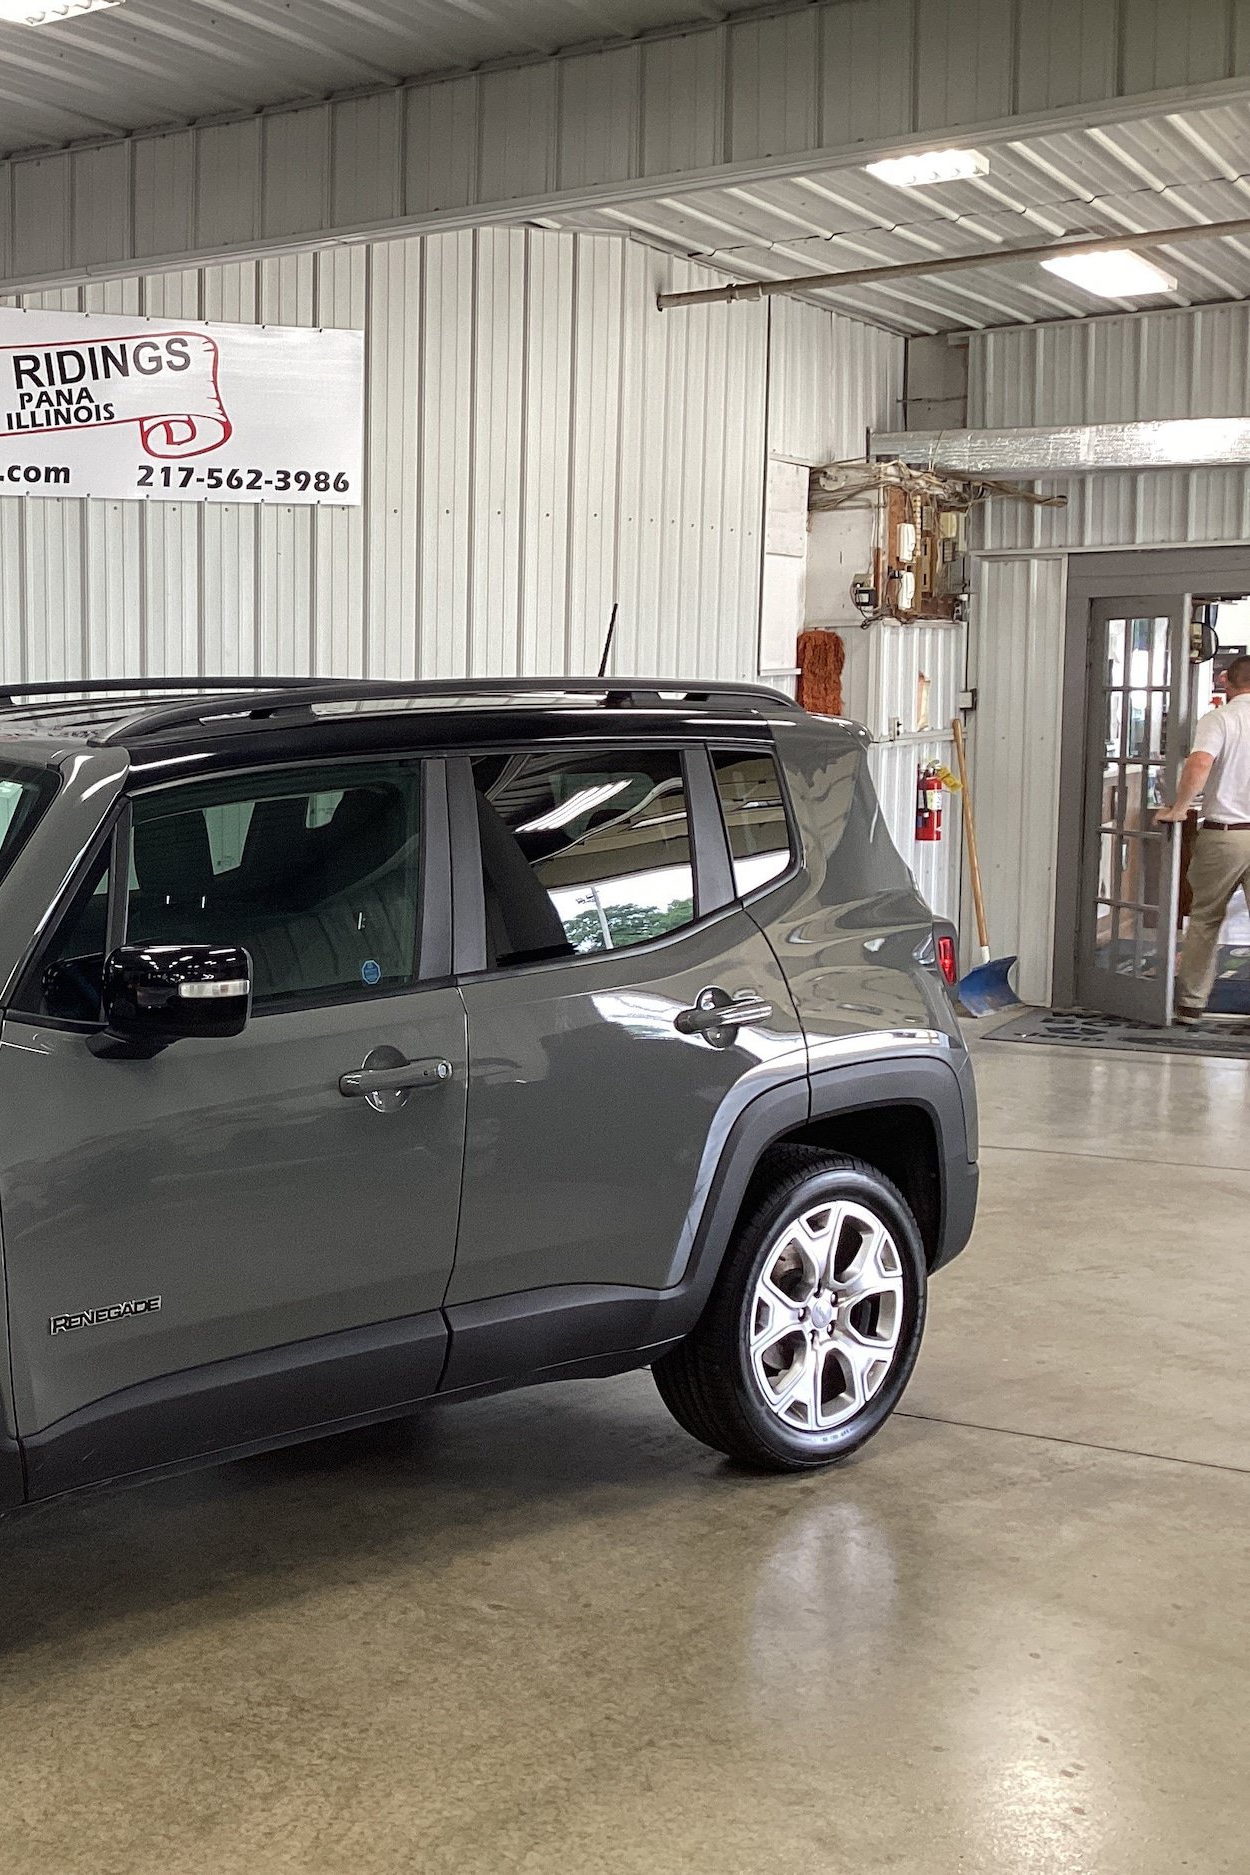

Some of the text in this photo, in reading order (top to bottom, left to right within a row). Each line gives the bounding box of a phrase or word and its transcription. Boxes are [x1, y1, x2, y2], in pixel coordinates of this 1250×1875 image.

[14, 338, 192, 390] RIDINGS
[19, 387, 95, 411] PANA
[7, 403, 115, 431] ILLINOIS
[136, 464, 351, 494] 217-562-3986
[50, 1295, 161, 1335] RENEGADE
